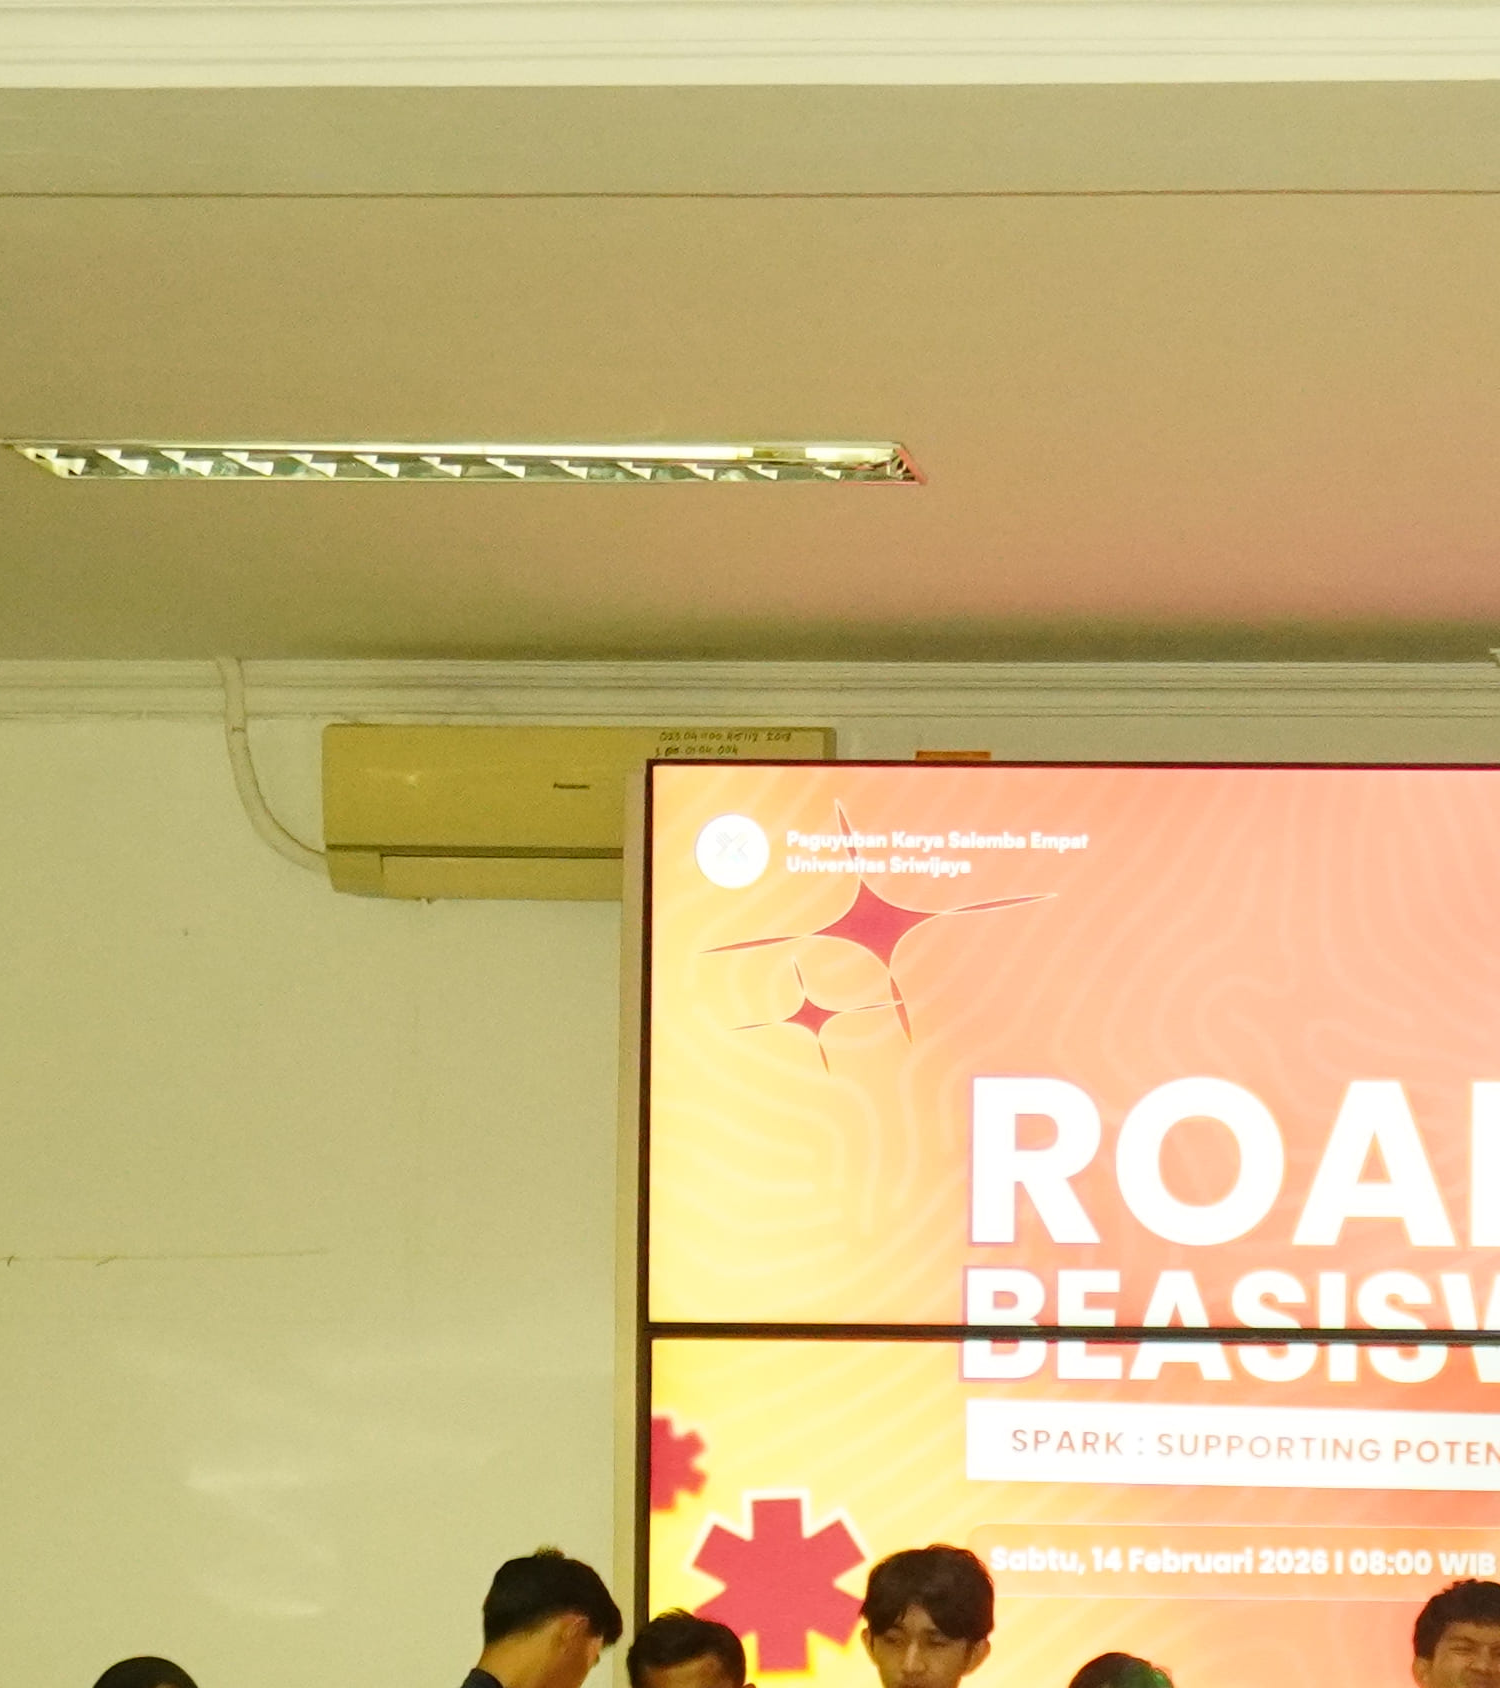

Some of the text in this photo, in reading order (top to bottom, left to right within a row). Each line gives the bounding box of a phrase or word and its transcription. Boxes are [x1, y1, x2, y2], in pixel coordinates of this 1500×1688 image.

[786, 831, 1089, 853] Paguyuban Karya Salemba Empat
[786, 855, 972, 878] Universitas Sriwijaya
[1011, 1428, 1125, 1456] SPARK
[1156, 1432, 1382, 1462] SUPPORTING
[989, 1546, 1087, 1576] Sabtu,
[1091, 1547, 1122, 1573] 14
[1127, 1546, 1253, 1574] Februari
[1258, 1549, 1329, 1575] 2026
[1349, 1550, 1434, 1577] 08:00
[1438, 1551, 1497, 1577] WIB
